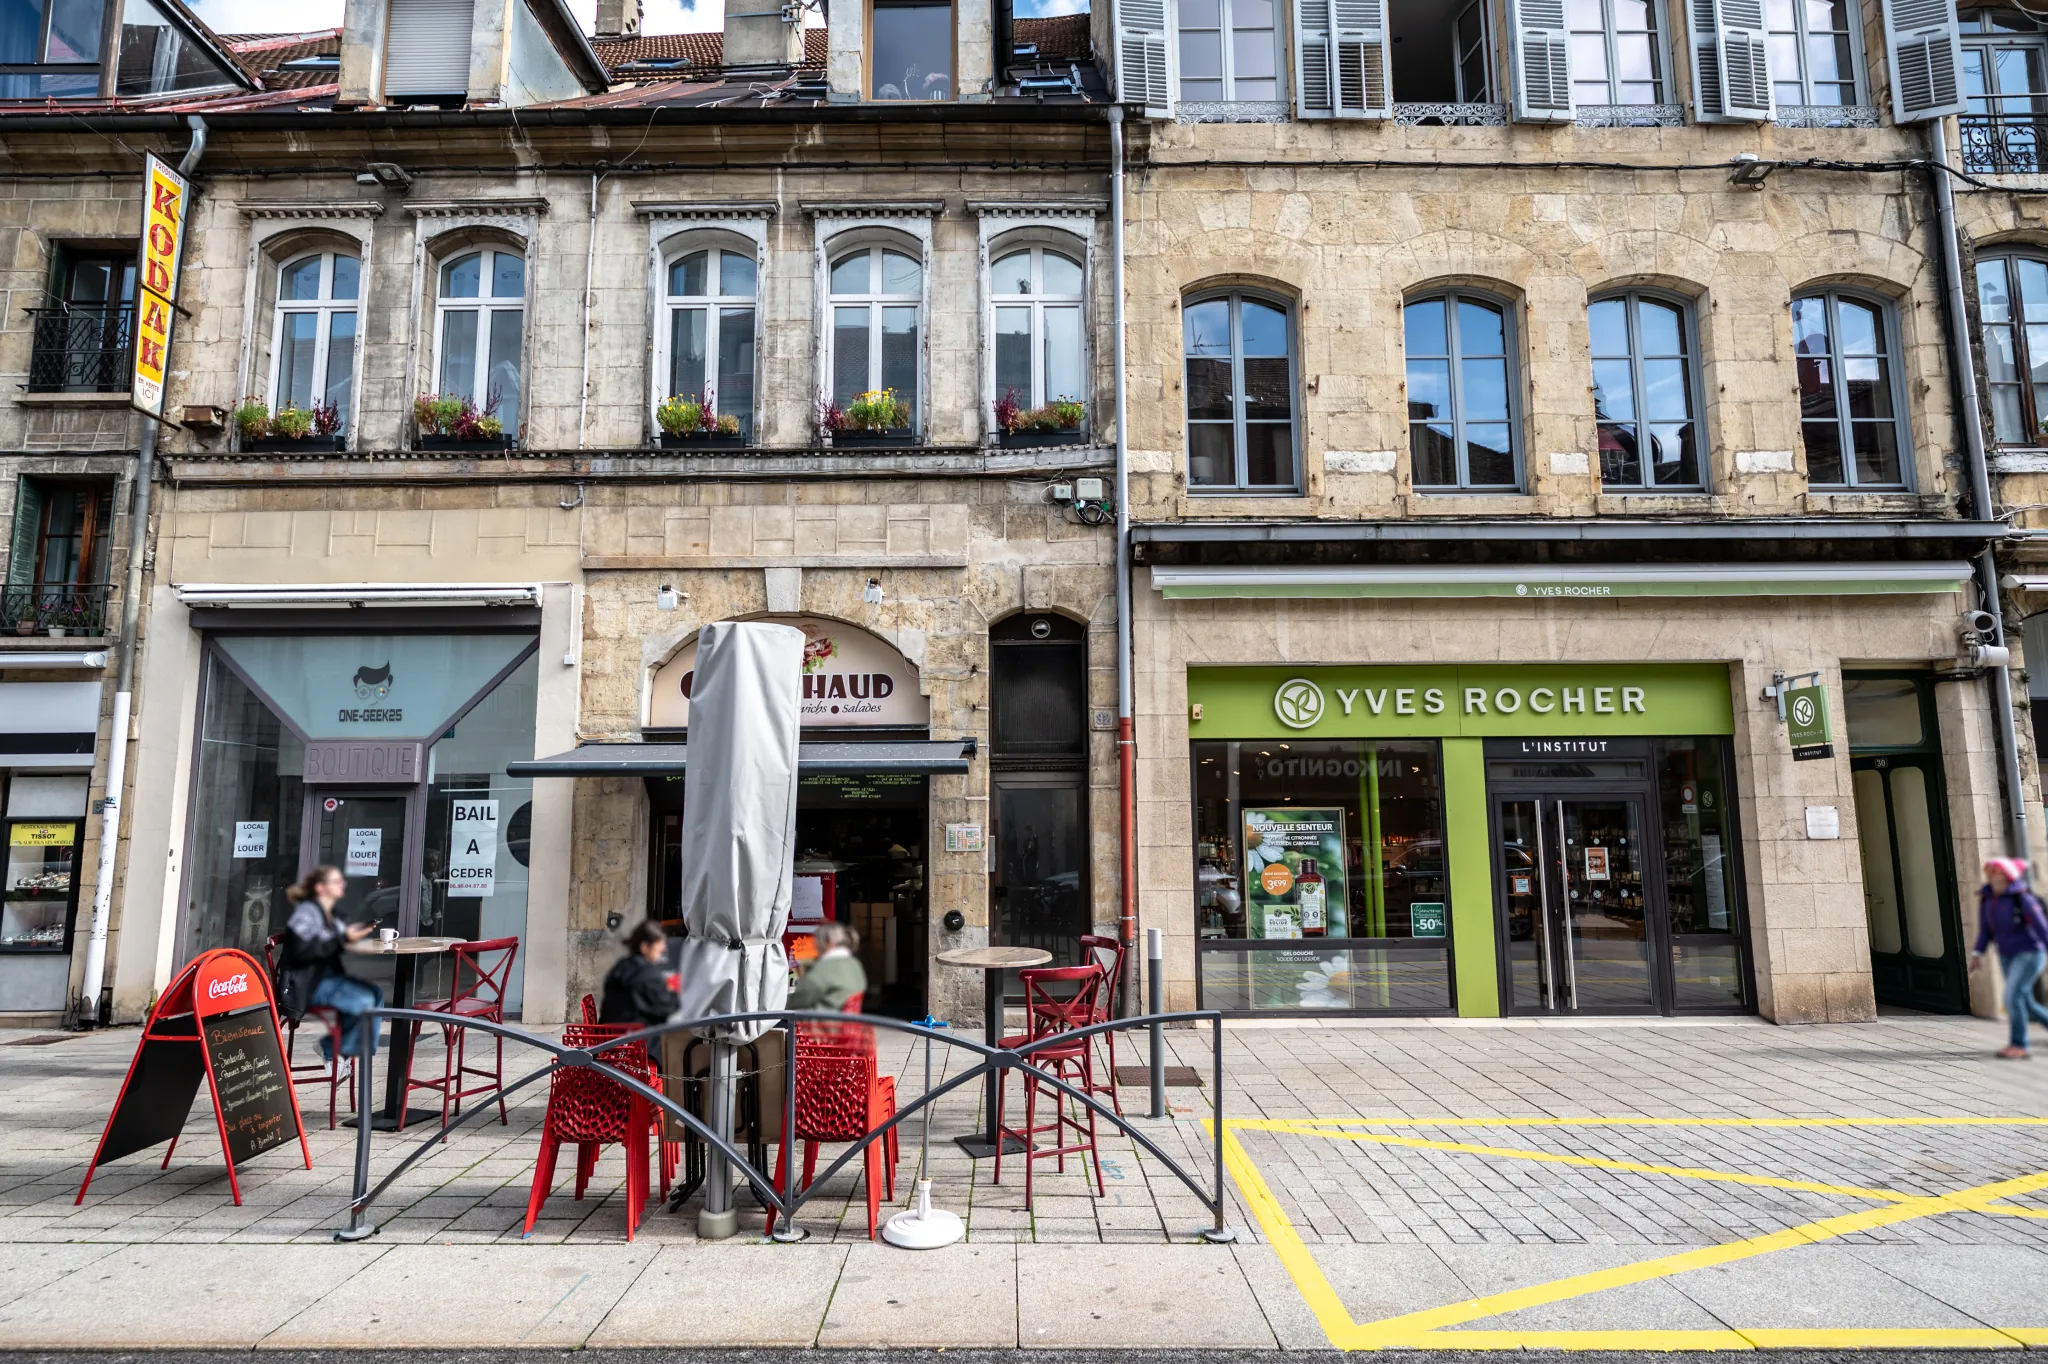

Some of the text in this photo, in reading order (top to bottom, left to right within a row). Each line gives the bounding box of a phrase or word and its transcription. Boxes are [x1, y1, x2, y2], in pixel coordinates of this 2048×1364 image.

[155, 160, 181, 185] PRODUITS
[140, 181, 177, 372] KODAK
[145, 381, 160, 393] VENTE
[142, 387, 154, 401] ICI
[1533, 586, 1611, 596] YVES ROCHER
[1335, 686, 1646, 715] YVES ROCHER
[338, 708, 403, 722] ONE-GEEK25
[1522, 741, 1608, 752] L'INSTITUT
[308, 747, 412, 777] BOUTIQUE
[1876, 759, 1886, 767] 30
[454, 806, 496, 821] BAIL
[1252, 823, 1333, 832] NOUVELLE SENTEUR
[237, 844, 265, 852] LOUER
[466, 838, 480, 855] A
[350, 851, 377, 859] LOUER
[450, 868, 493, 878] CEDER
[1267, 879, 1287, 890] 3€99
[1415, 918, 1443, 930] -50%
[208, 973, 248, 999] Coca-Cola
[211, 1025, 266, 1047] Bienvenue
